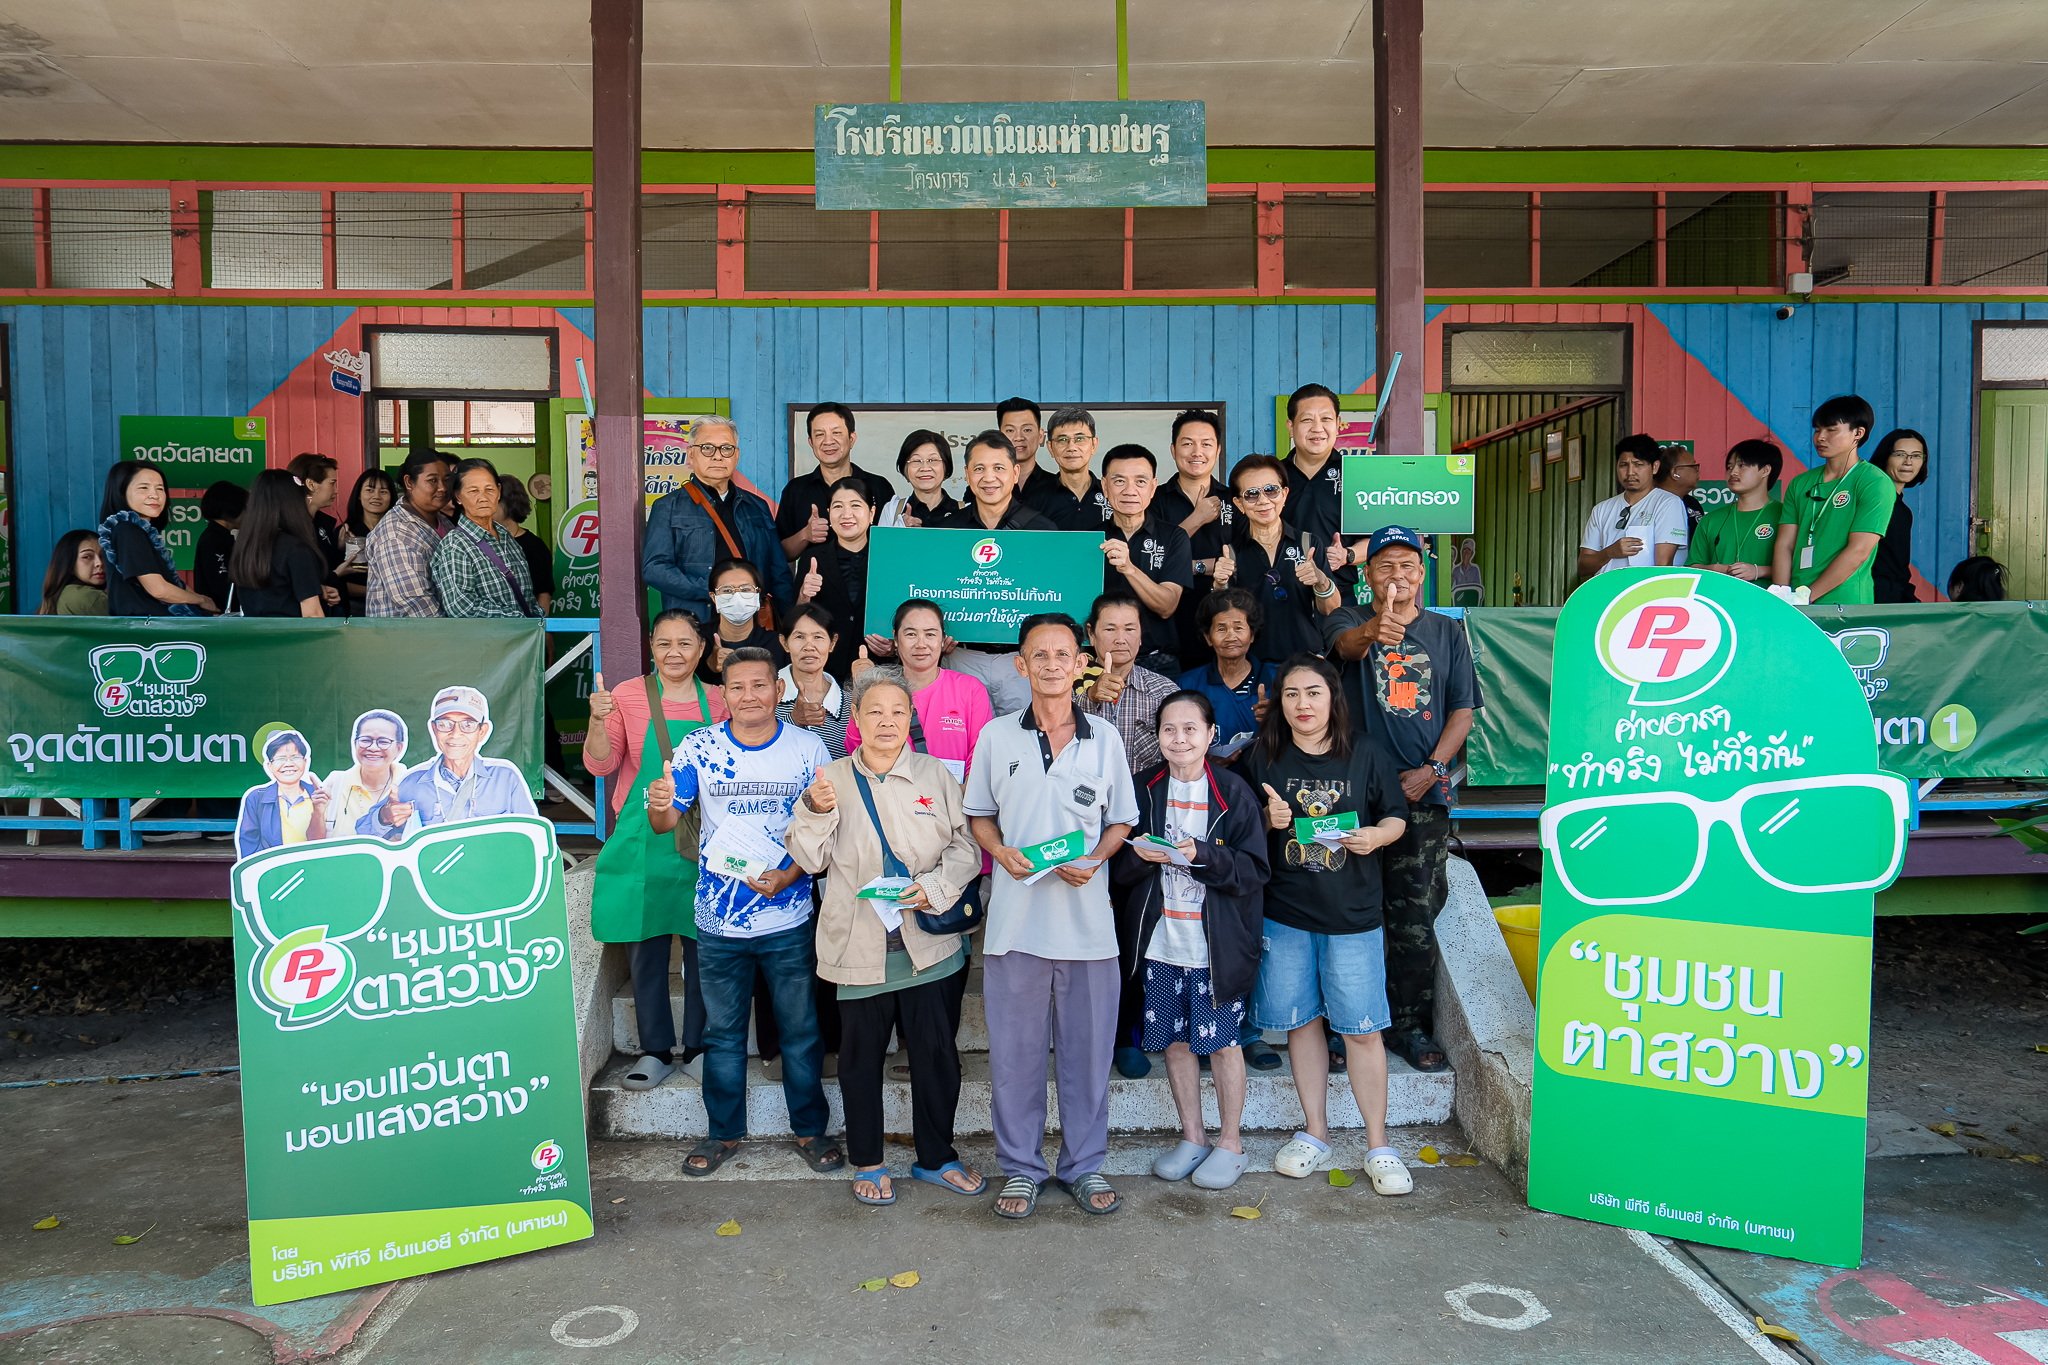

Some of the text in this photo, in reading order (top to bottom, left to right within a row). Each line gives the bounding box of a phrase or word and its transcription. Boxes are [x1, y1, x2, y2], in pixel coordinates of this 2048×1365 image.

[133, 441, 253, 464] จดวัดสายตา
[1355, 486, 1461, 511] จุดคัดกรอง
[979, 545, 996, 562] PT
[908, 584, 1062, 602] โครงการพีทีทำจริงไม่ทิ้งกัน
[1627, 606, 1706, 677] PT
[106, 686, 124, 705] PT
[129, 694, 204, 714] ตาสว่าง”
[135, 681, 185, 699] “ชุมชน
[1615, 704, 1732, 743] ค่ายอาสา
[1943, 712, 1957, 744] 1
[6, 723, 247, 773] จุดตัดแว่นตา
[1549, 730, 1815, 789] "ทำจริง ไม่ทิ้งกัน"
[1285, 777, 1352, 797] FENDI
[728, 799, 779, 815] GAMES
[366, 918, 502, 968] “ชุมชน
[284, 948, 337, 999] PT
[353, 944, 555, 1011] ตาสว่าง”
[1569, 939, 1784, 1022] “ชุมชน
[301, 1050, 511, 1107] “มอบแว่นตา
[1562, 1020, 1865, 1099] ตาสว่าง”
[286, 1076, 550, 1153] มอบแสงสว่าง”
[540, 1147, 557, 1166] PT
[1589, 1192, 1795, 1243] บริษัท พีทีจี เอ็นเนอยี จำกัด (มหาชน)
[272, 1210, 569, 1283] บริษัท พีทีจี เอ็นเนอยี จำกัด (มหาชน)
[272, 1246, 299, 1262] โดย
